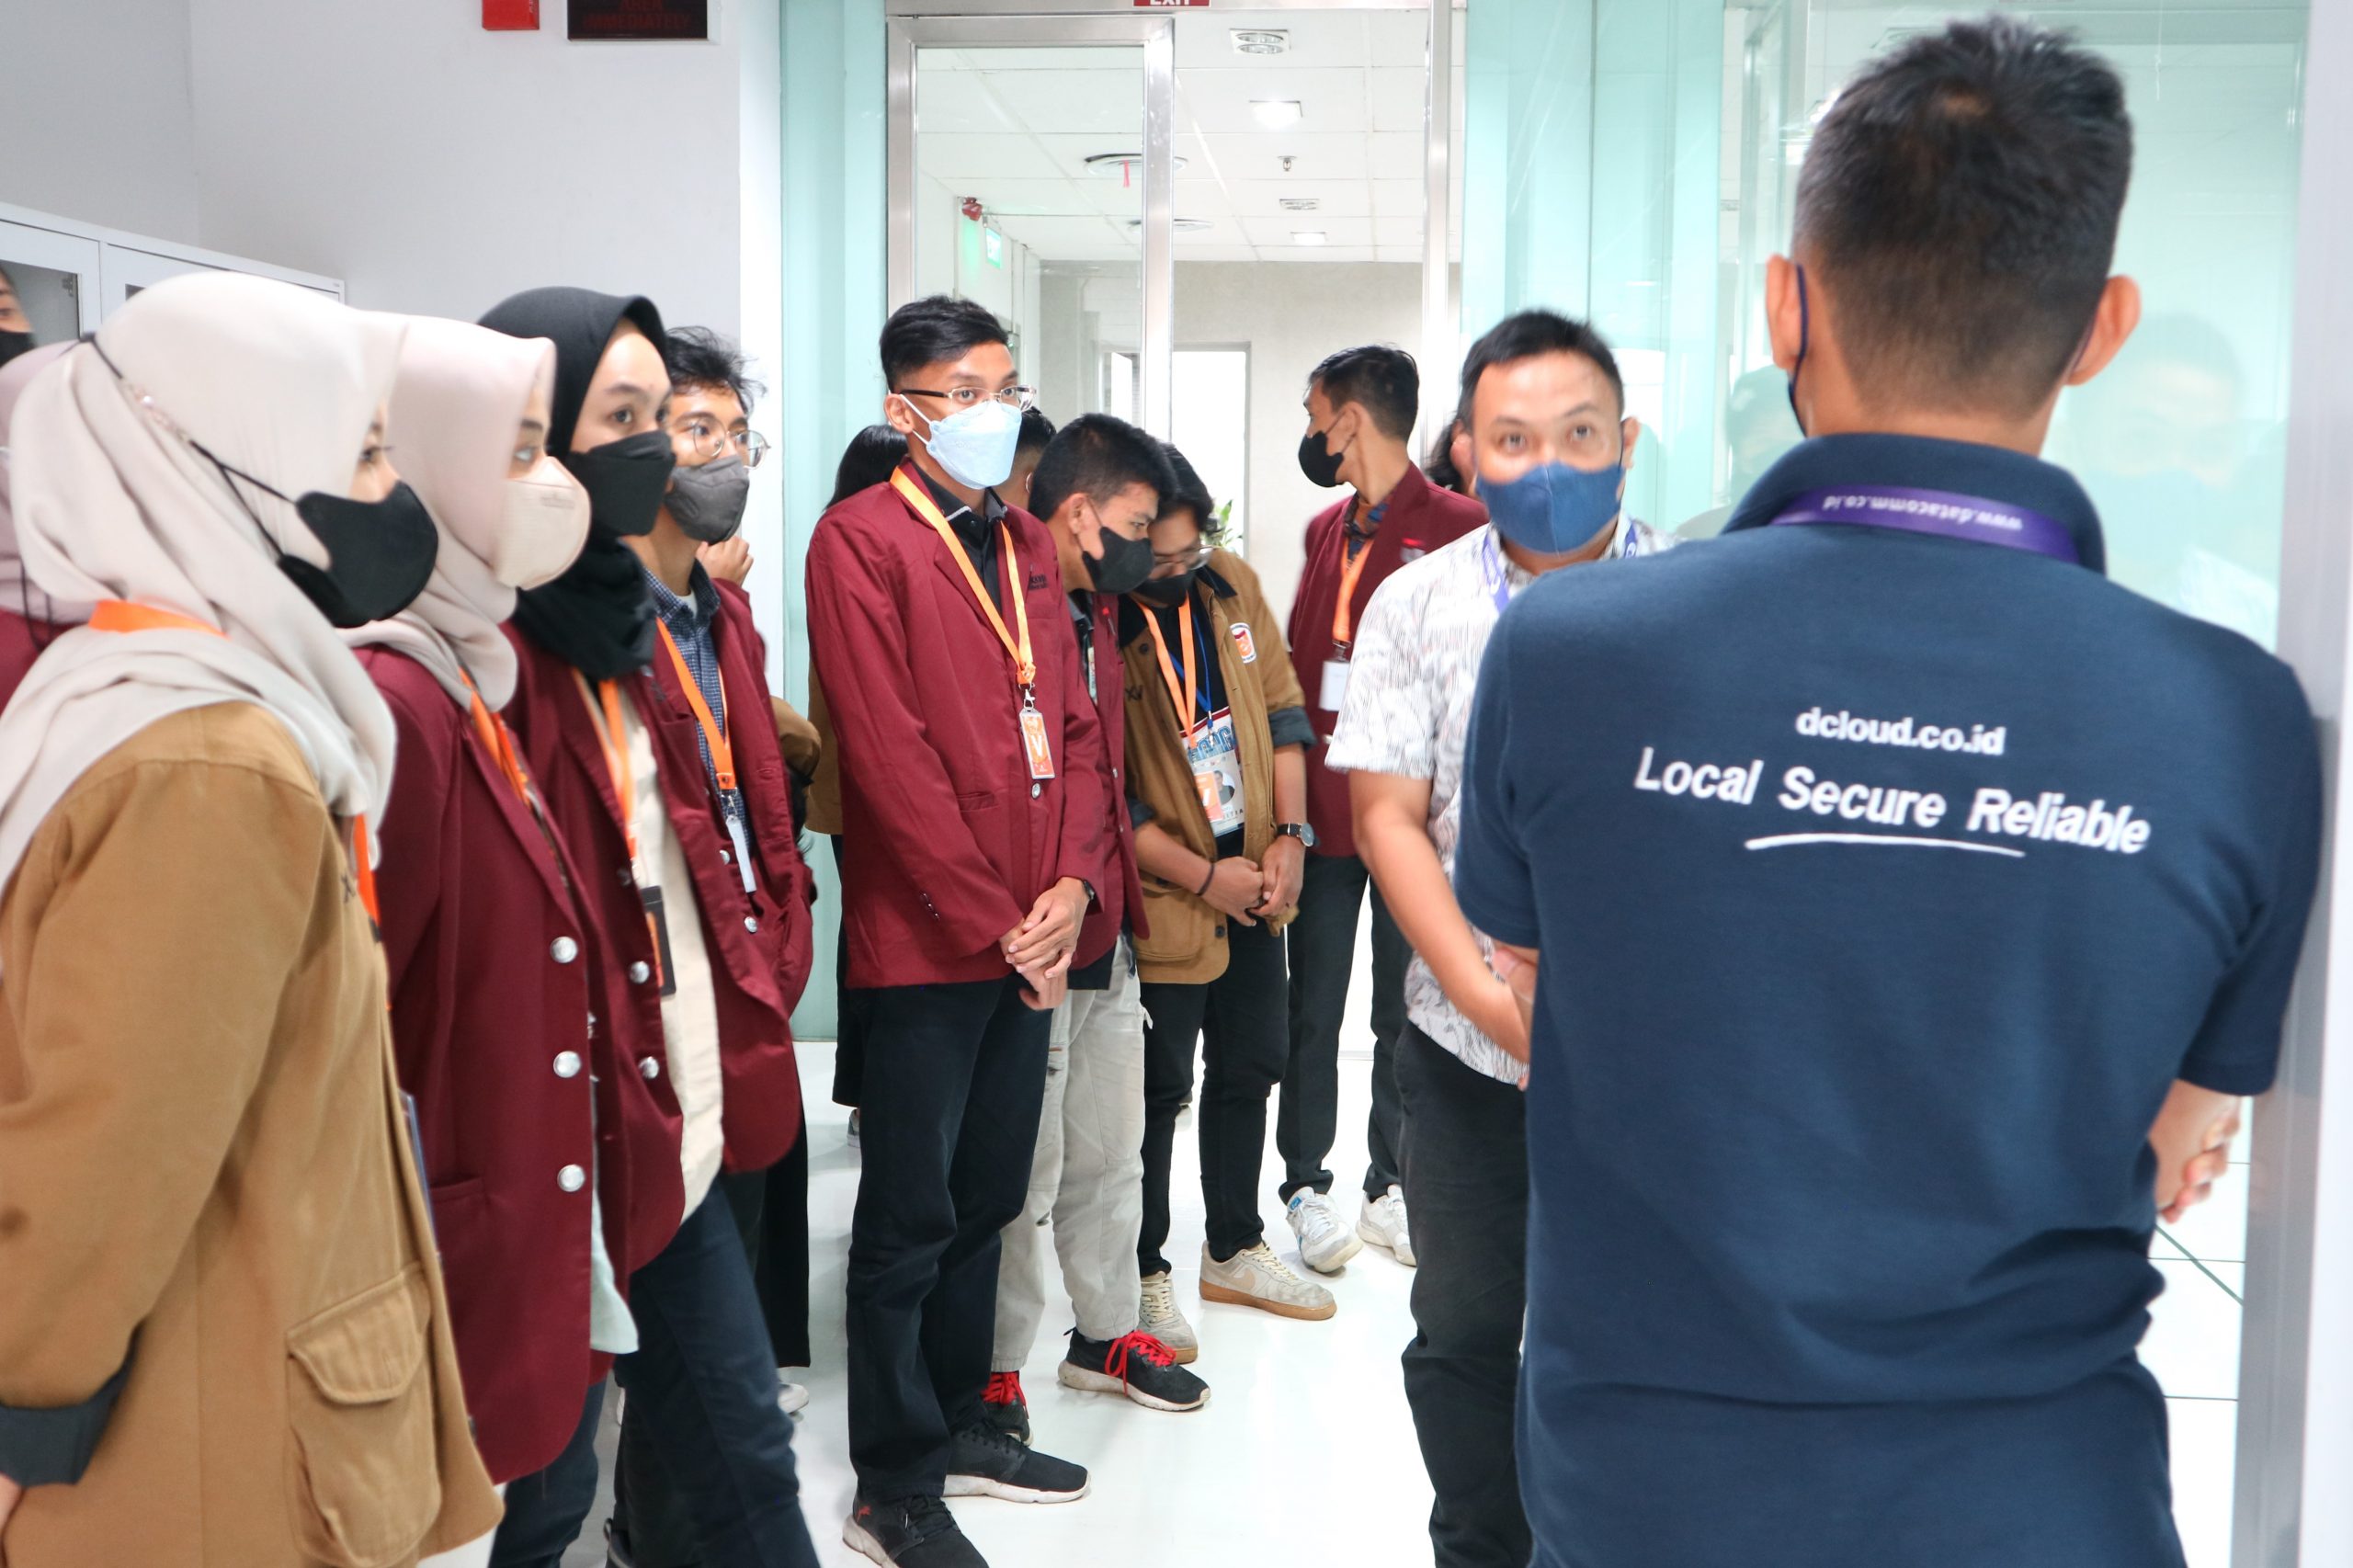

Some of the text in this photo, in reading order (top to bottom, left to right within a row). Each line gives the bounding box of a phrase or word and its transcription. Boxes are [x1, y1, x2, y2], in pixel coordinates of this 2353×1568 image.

[1823, 495, 2023, 530] www.datacomm.co.id
[1795, 706, 2006, 756] dcloud.co.id
[1634, 746, 2151, 854] Local Secure Reliable
